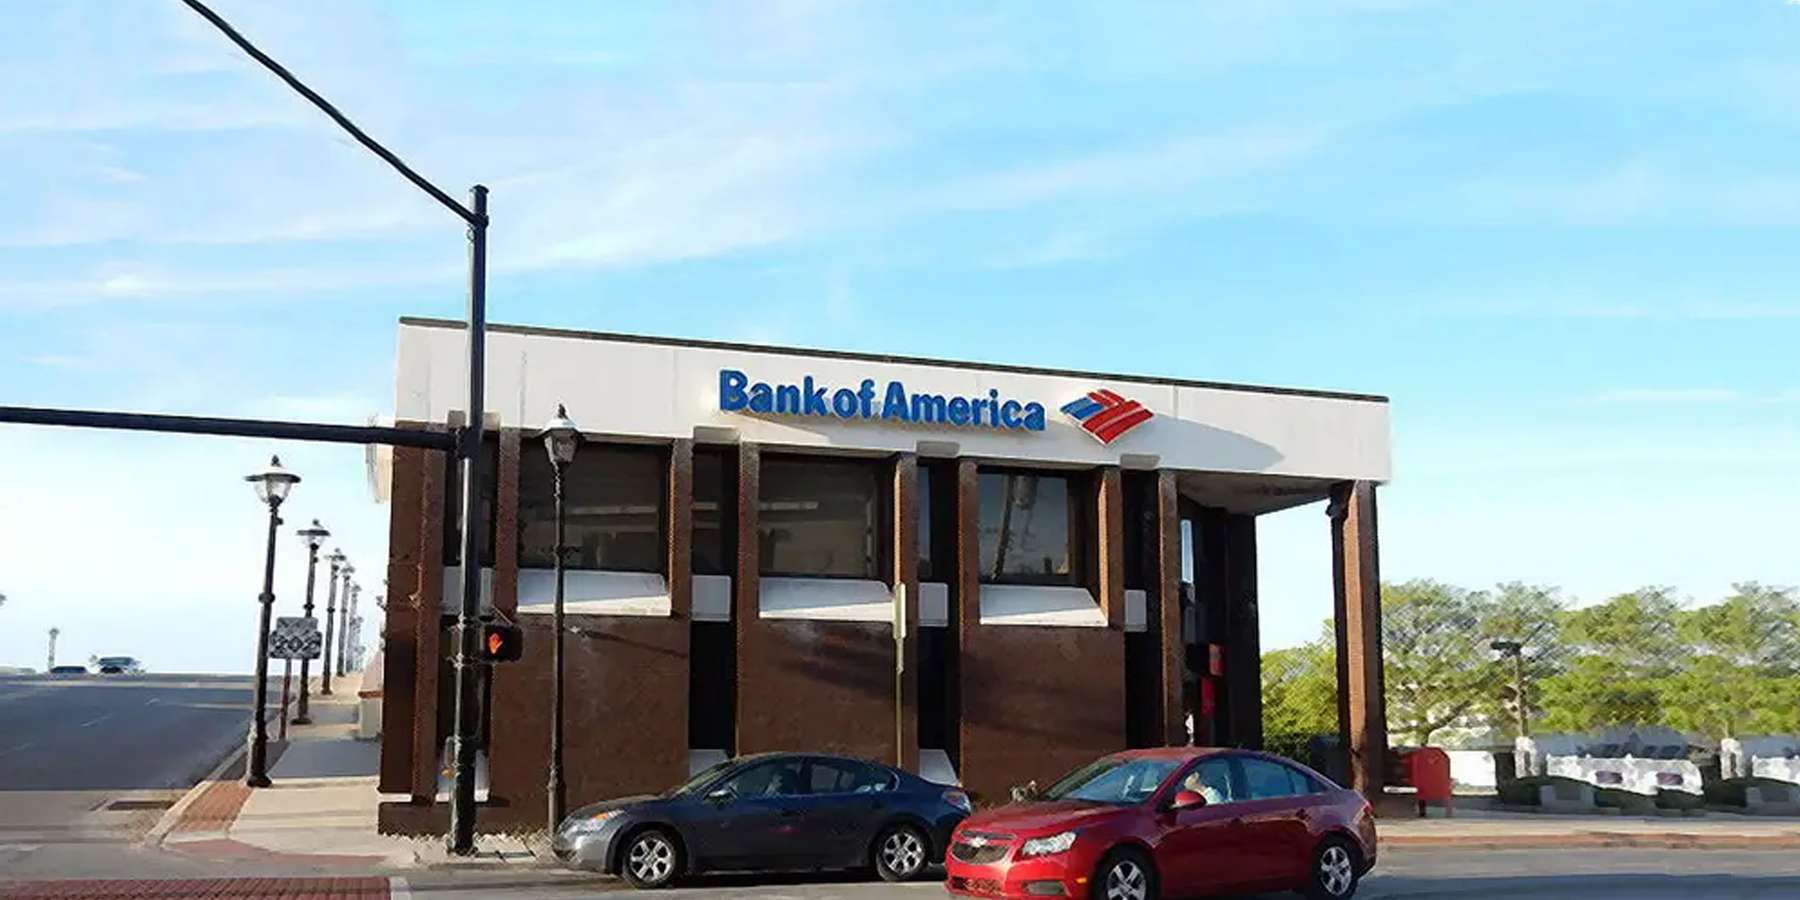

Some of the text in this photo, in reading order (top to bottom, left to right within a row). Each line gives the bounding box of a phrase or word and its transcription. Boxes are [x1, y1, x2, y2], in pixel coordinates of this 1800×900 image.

[719, 369, 1046, 432] Bank of America
